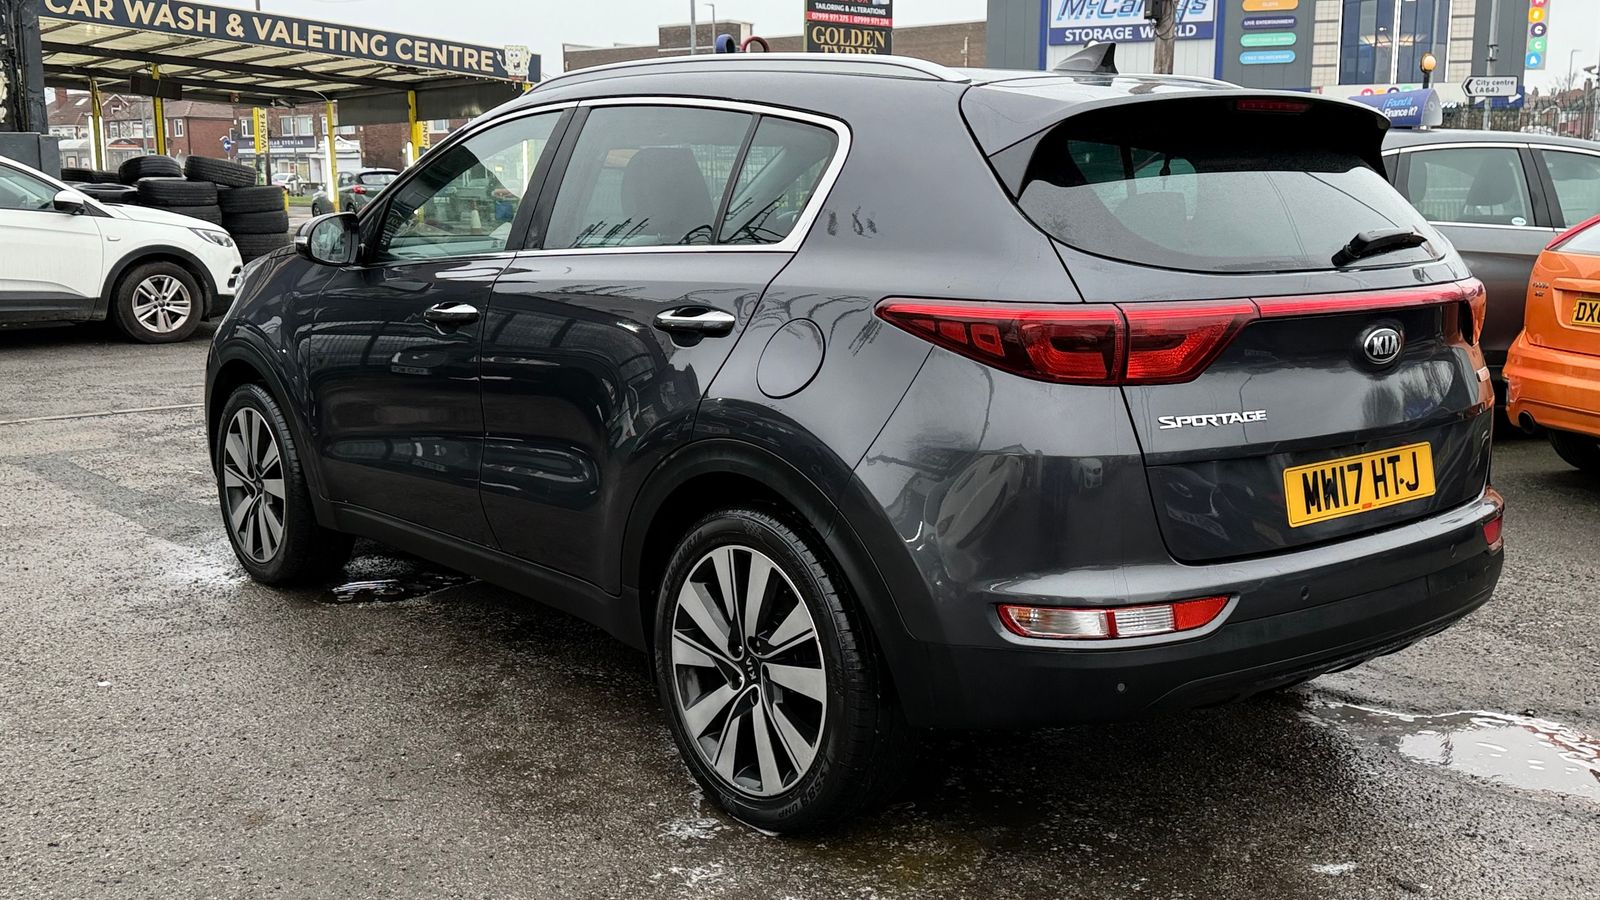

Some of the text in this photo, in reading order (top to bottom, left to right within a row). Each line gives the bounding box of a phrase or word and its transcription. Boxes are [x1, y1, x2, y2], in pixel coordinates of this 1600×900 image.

[814, 2, 845, 12] TAILORING
[850, 6, 886, 16] ALTERATIONS
[45, 0, 495, 72] CAR WASH & VALETING CENTRE
[812, 26, 886, 48] GOLDEN
[1064, 23, 1197, 42] STORAGE WLD
[1384, 106, 1418, 117] Finance it?
[260, 122, 268, 149] WASH
[1575, 302, 1600, 323] DX
[1372, 334, 1398, 356] KIA
[1157, 409, 1268, 430] SPORTAGE
[1301, 451, 1421, 516] MW17 HTJ
[745, 657, 757, 680] KIA
